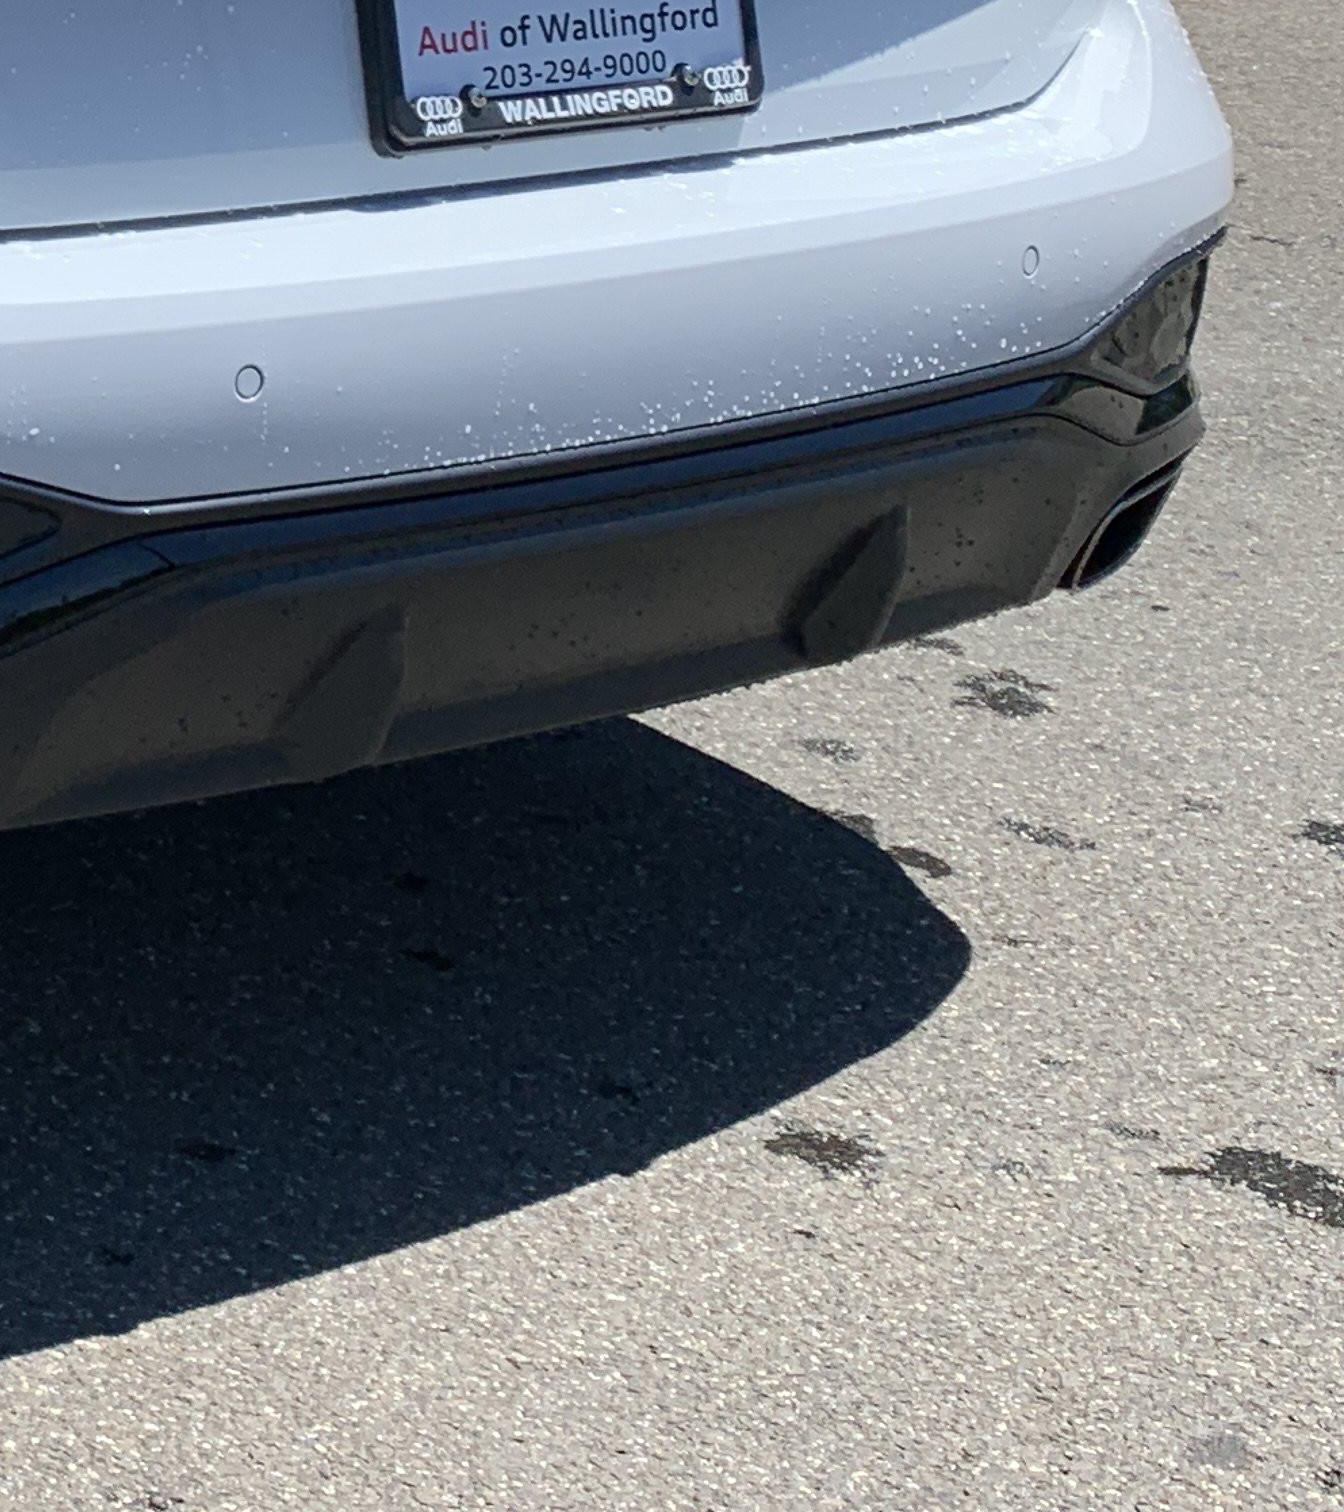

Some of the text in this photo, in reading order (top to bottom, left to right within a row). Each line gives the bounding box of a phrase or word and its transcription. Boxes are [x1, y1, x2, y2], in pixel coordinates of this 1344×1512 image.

[418, 0, 719, 57] Audi of Wallingford
[483, 48, 667, 90] 203-294-9000
[498, 85, 674, 124] WALLINGFORD
[713, 87, 749, 106] Audi
[424, 118, 464, 137] Audi
